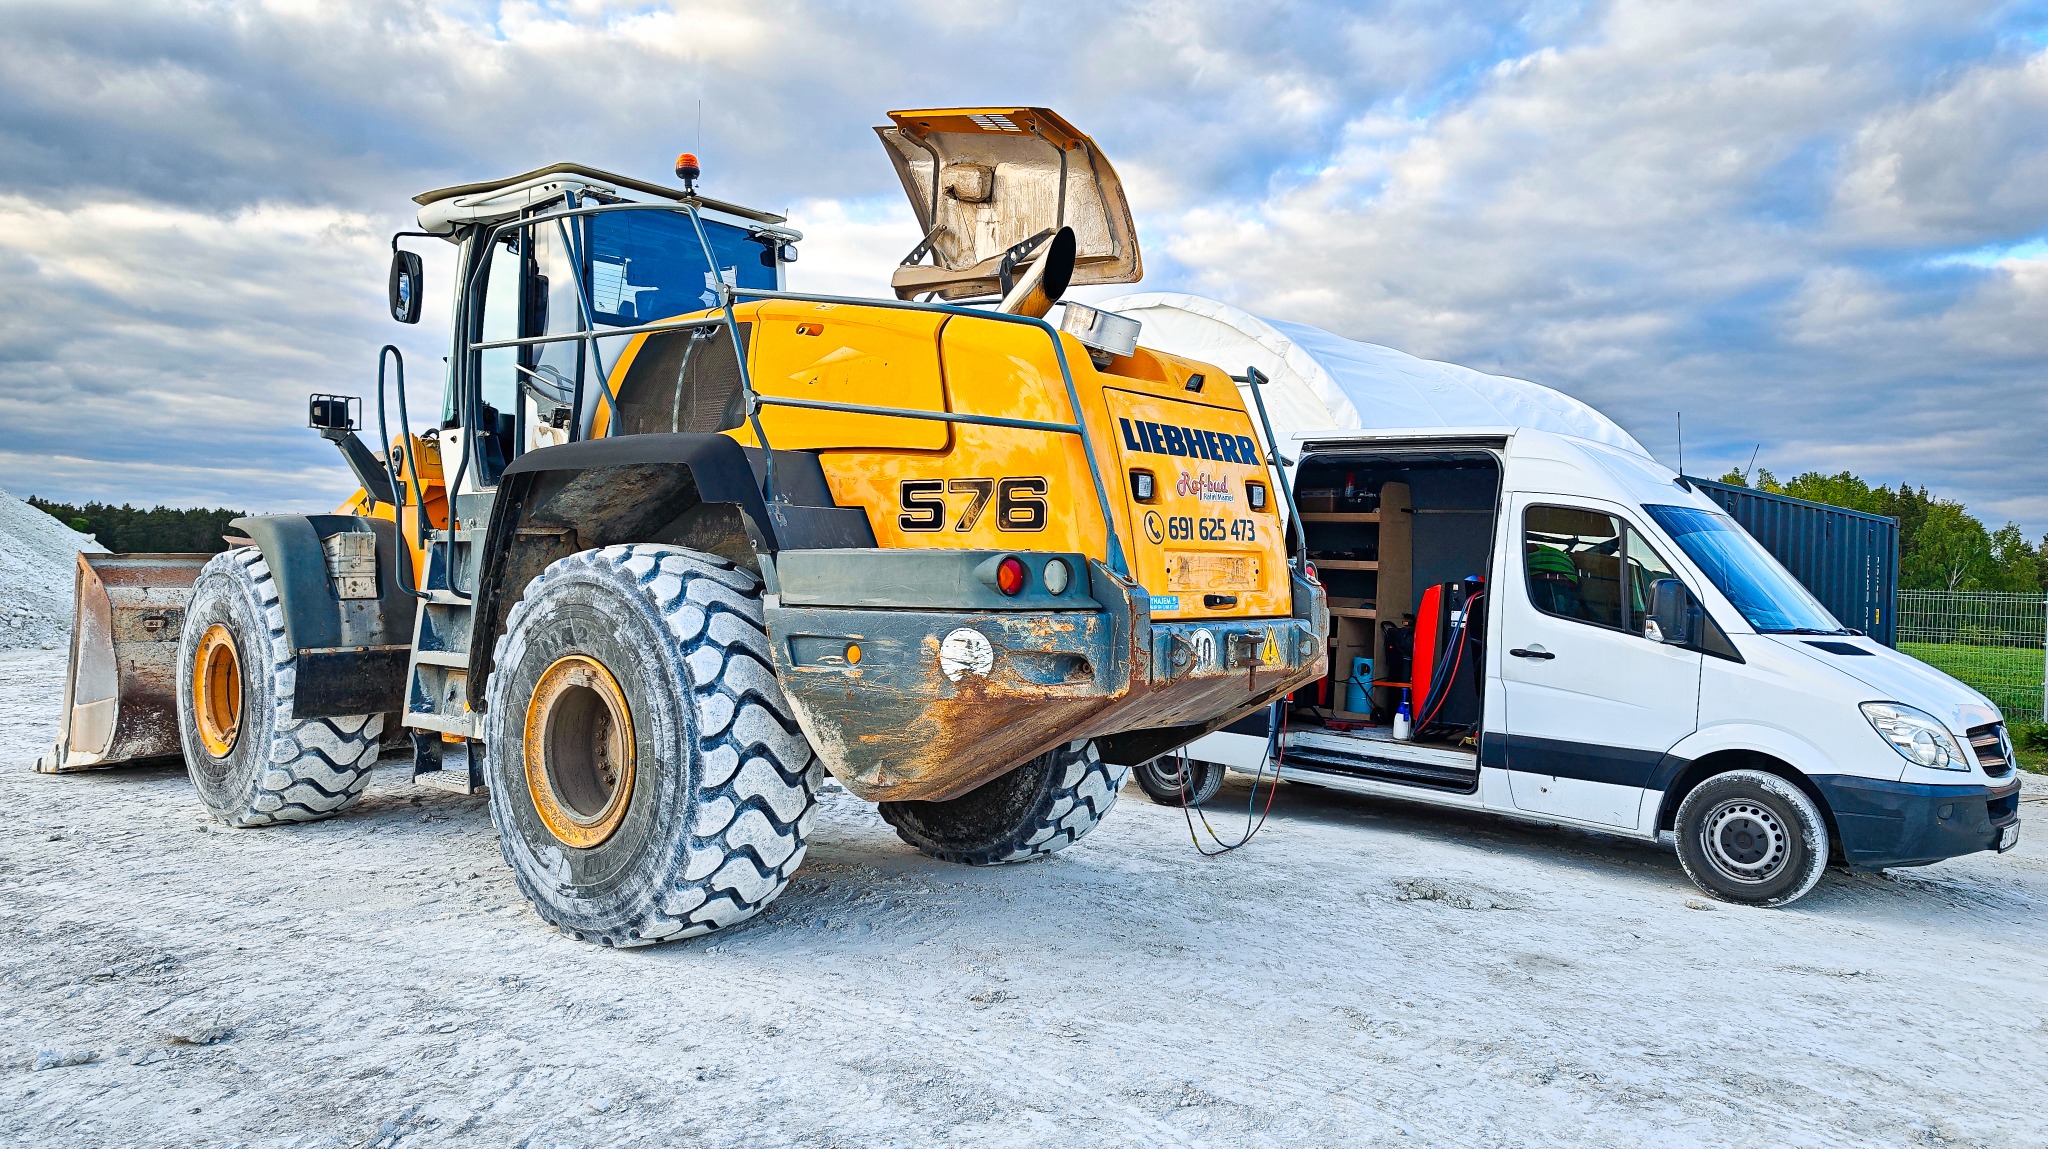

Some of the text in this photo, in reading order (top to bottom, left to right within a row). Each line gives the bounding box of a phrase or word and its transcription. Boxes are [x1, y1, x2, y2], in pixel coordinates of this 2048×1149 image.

[1118, 417, 1261, 466] LIEBHERR
[898, 476, 1049, 532] 576
[1168, 516, 1256, 542] 691 625 473
